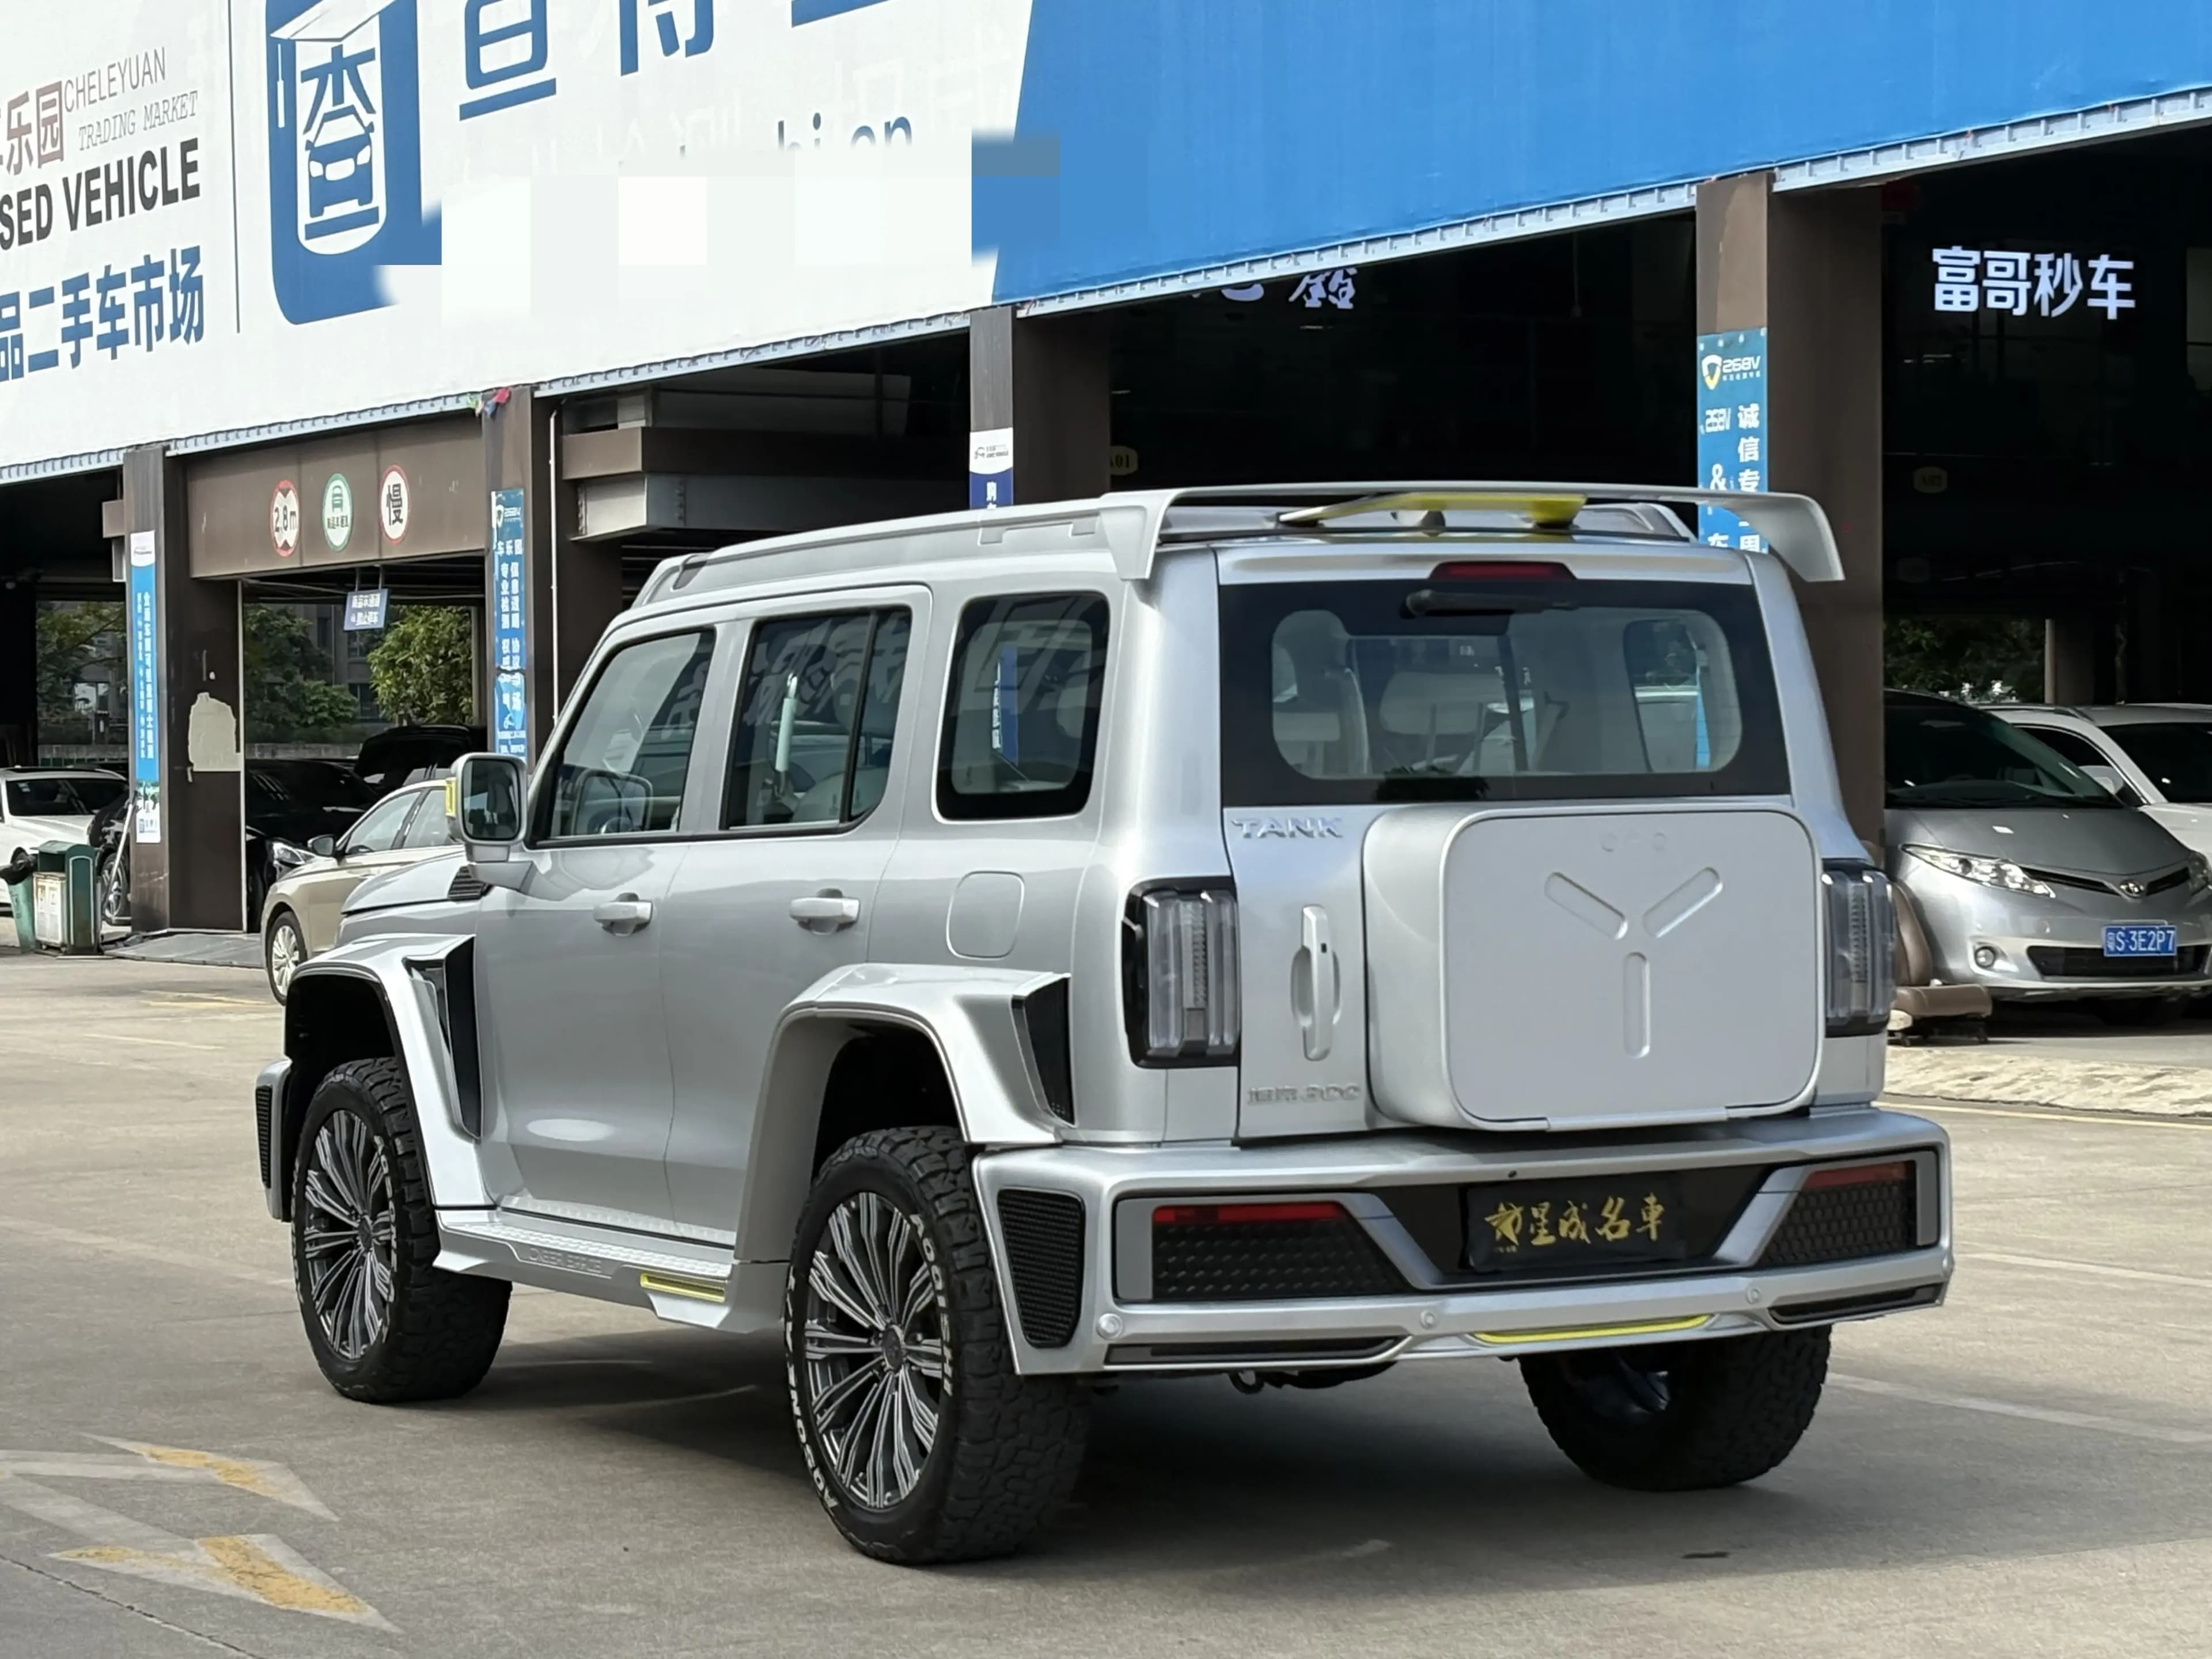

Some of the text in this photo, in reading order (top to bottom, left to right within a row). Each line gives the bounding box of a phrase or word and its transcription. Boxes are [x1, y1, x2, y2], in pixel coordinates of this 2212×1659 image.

[64, 46, 166, 113] CHELEYUAN
[0, 81, 65, 176] 乐园
[78, 90, 198, 151] TRADING MARKET
[63, 137, 201, 232] VEHICLE
[1931, 245, 2136, 320] 富哥秒车
[1111, 454, 1130, 468] 01
[386, 483, 404, 526] 慢
[1231, 816, 1343, 839] TANK
